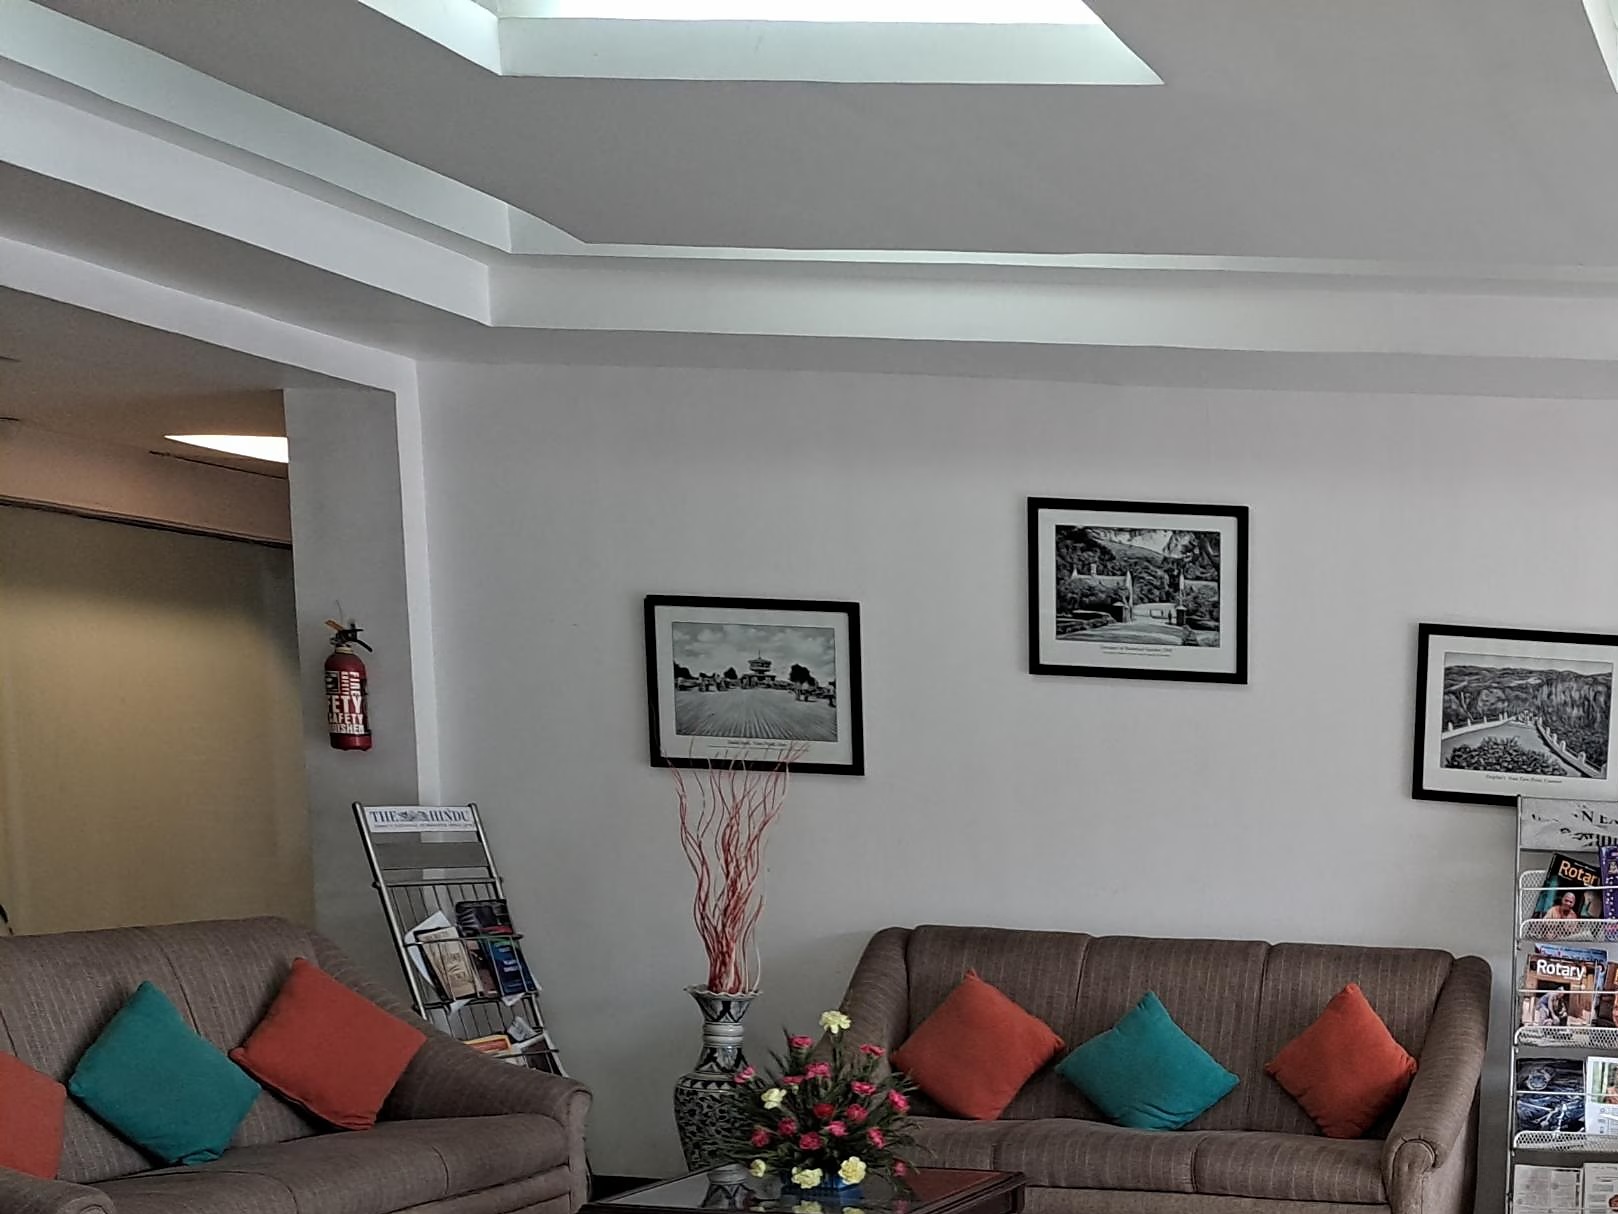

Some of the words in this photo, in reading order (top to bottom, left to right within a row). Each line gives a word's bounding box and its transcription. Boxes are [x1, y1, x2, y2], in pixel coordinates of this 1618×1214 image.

[369, 810, 398, 823] THE
[429, 809, 471, 822] HINDU
[1536, 959, 1585, 981] Rotary
